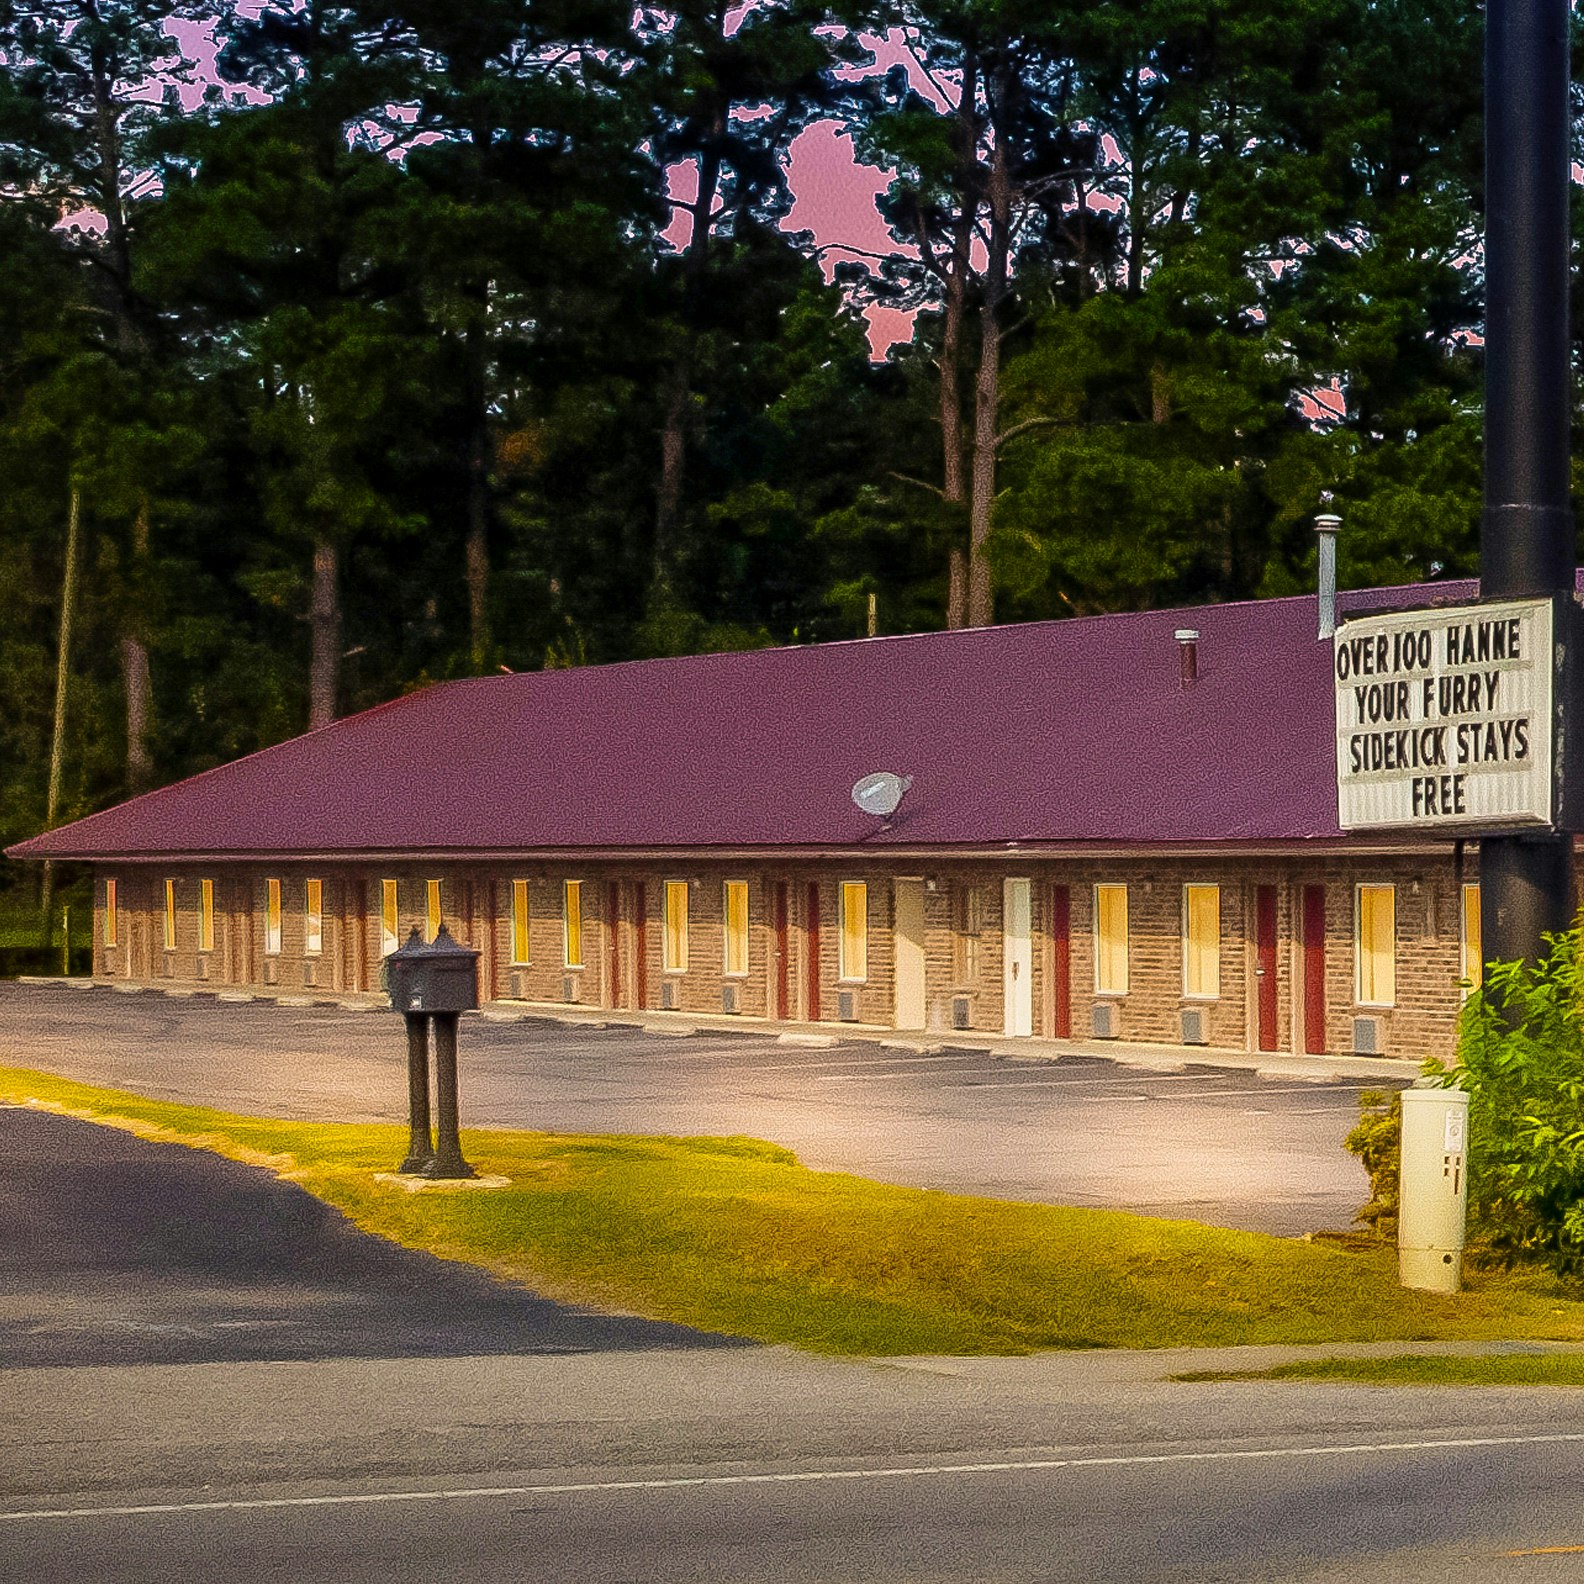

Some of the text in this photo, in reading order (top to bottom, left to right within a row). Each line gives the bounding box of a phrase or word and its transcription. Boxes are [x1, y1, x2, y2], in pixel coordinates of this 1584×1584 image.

[1447, 617, 1521, 665] HANNE
[1354, 669, 1500, 724] YOUR FURRY
[1350, 718, 1528, 774] SIDEKICK STAYS
[1412, 774, 1466, 817] FREE
